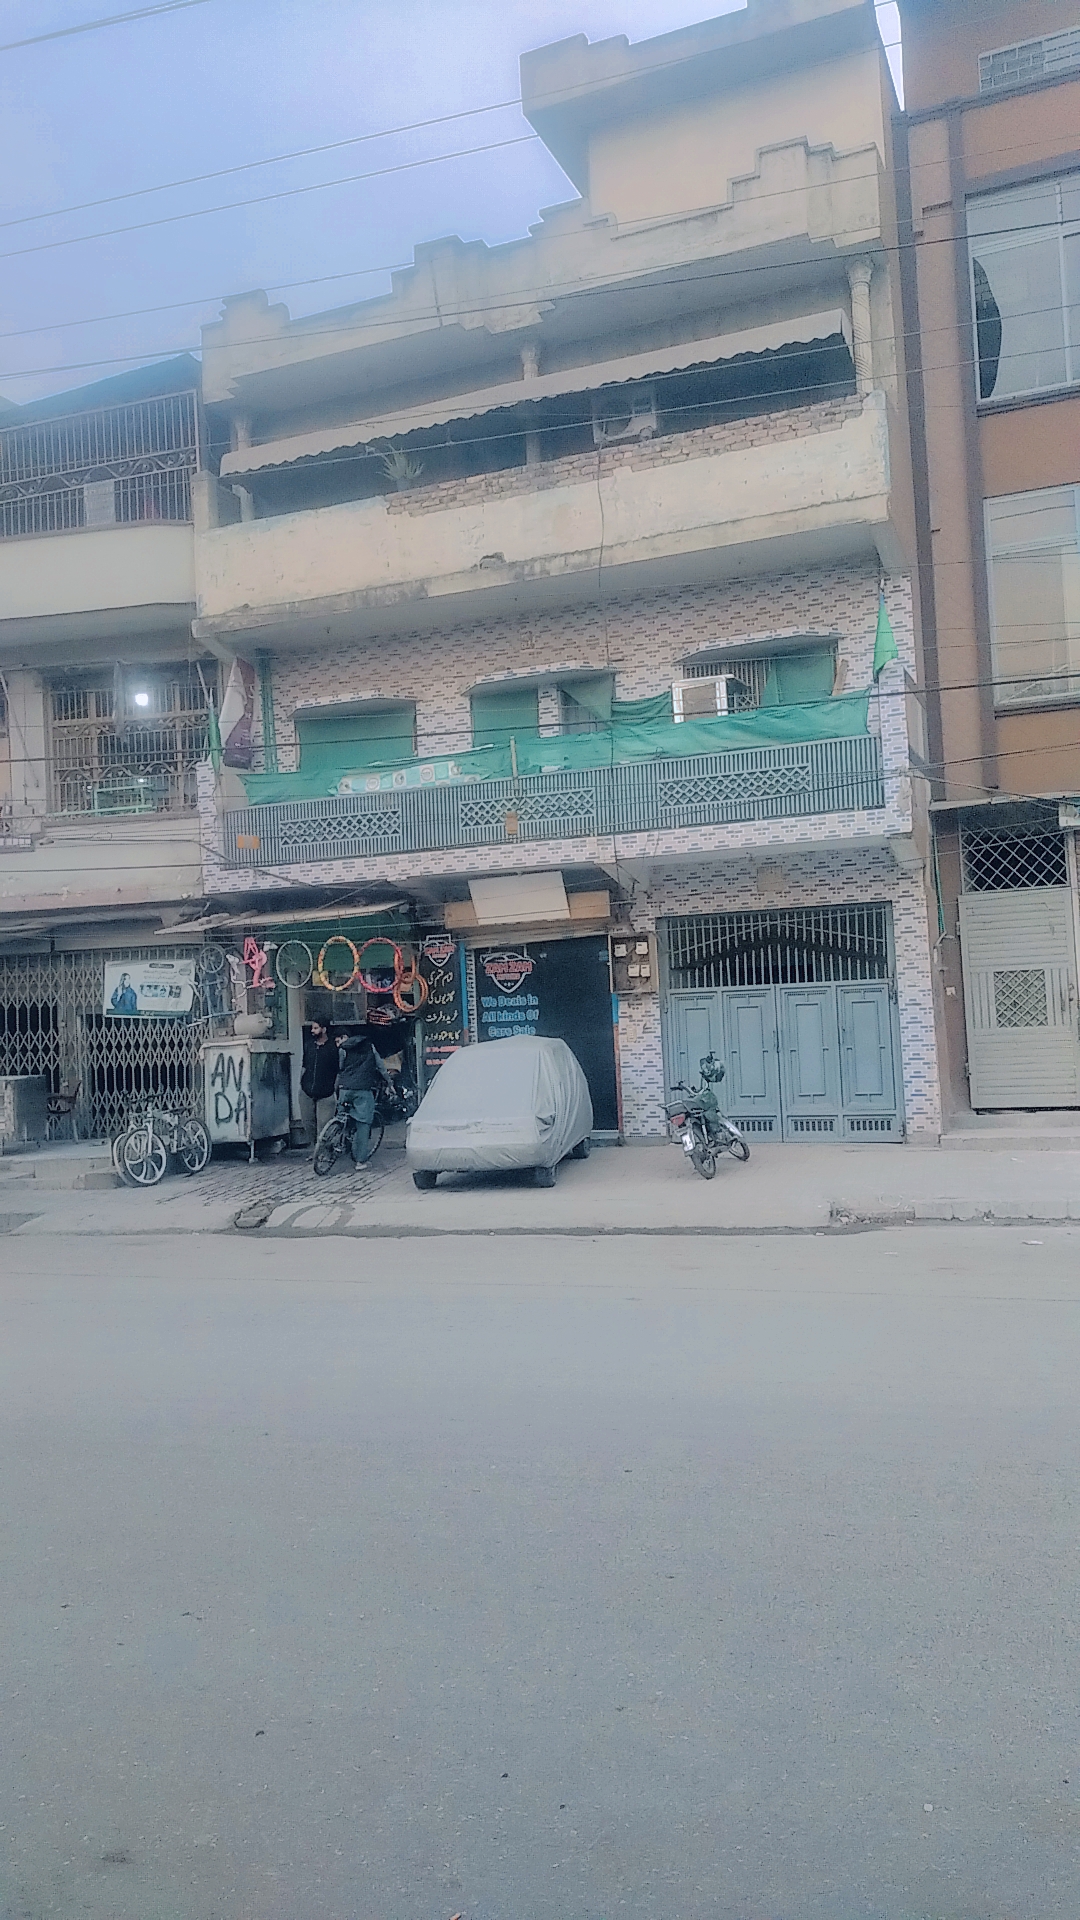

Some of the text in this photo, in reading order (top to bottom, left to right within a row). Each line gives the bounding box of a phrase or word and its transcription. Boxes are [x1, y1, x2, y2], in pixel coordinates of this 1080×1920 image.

[485, 960, 533, 974] ZAM ZAM
[481, 996, 497, 1007] We
[498, 994, 527, 1007] Deals
[481, 1011, 496, 1023] All
[526, 1008, 540, 1021] Of
[488, 1024, 536, 1037] Cars Sale
[211, 1053, 244, 1092] AN
[214, 1090, 247, 1127] DA
